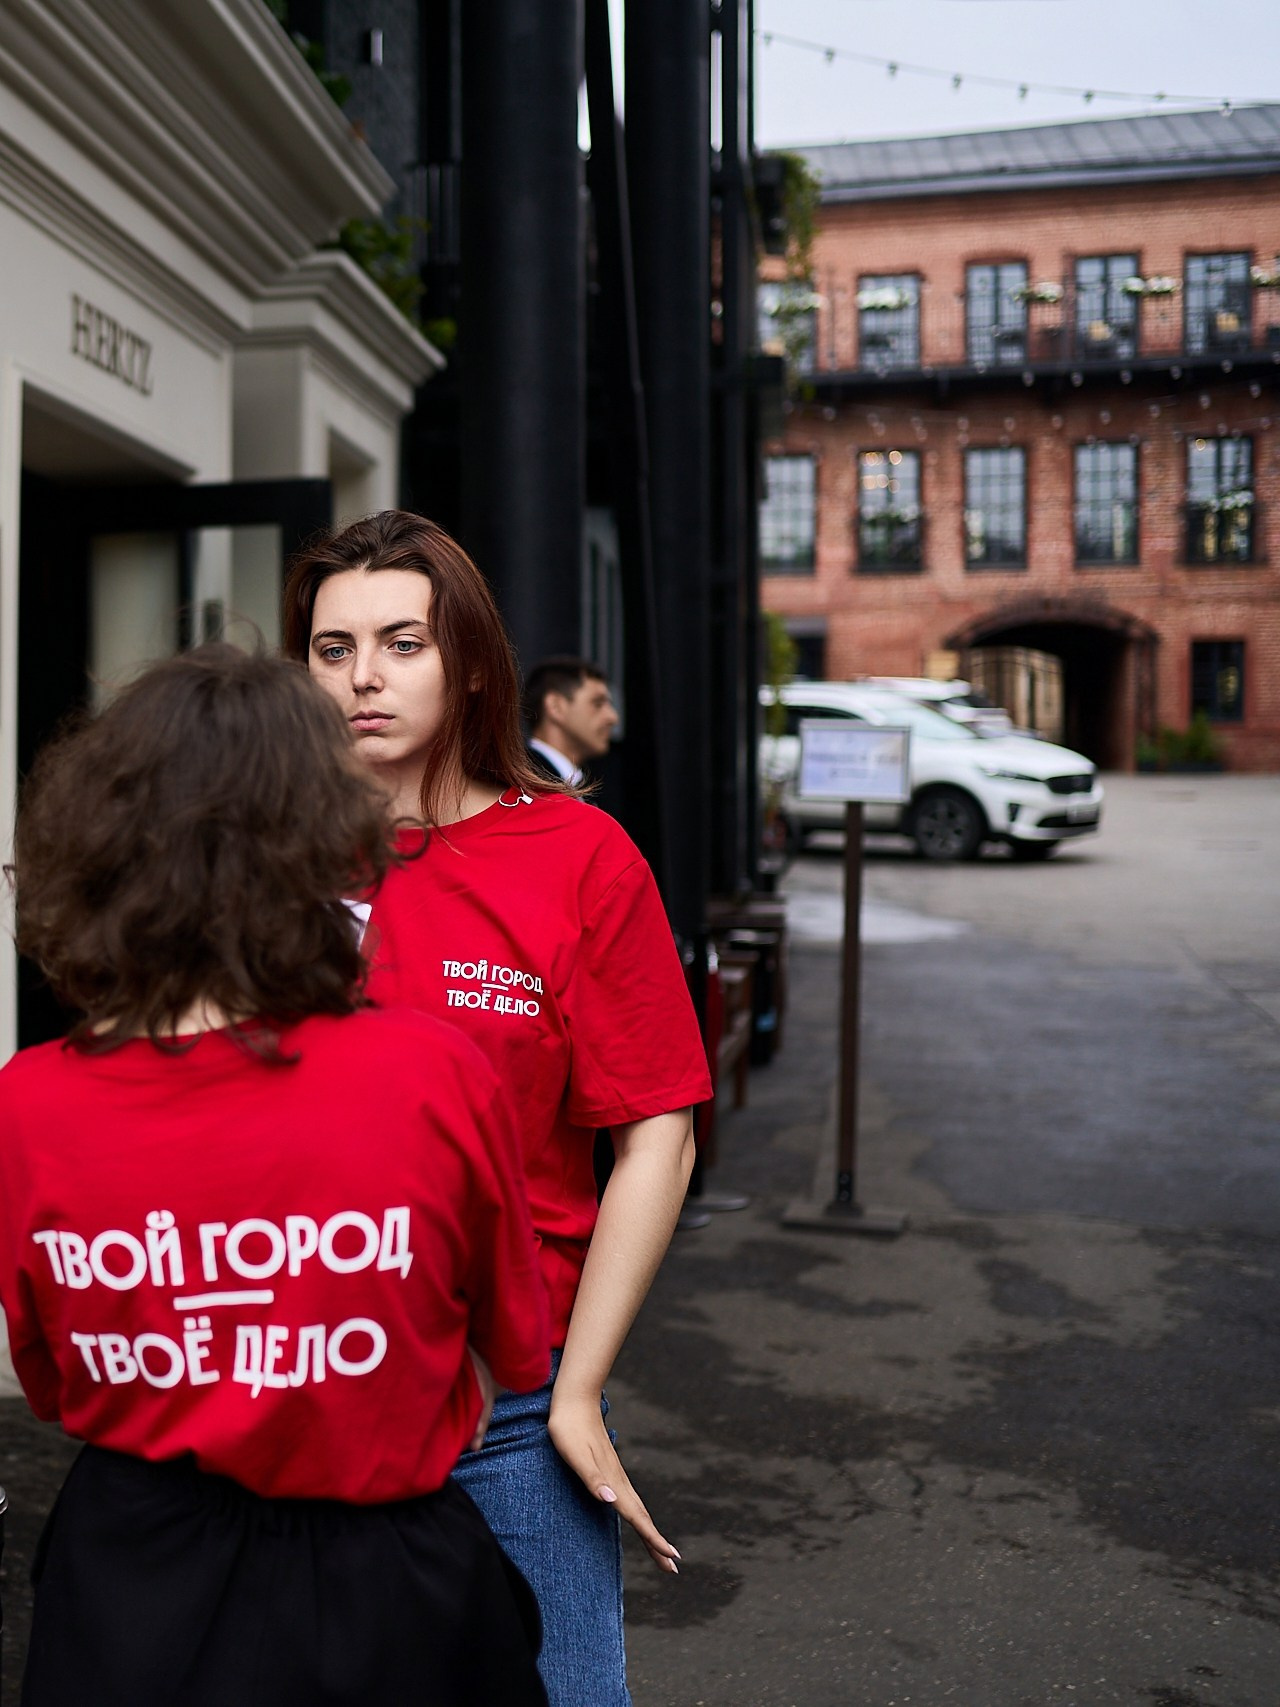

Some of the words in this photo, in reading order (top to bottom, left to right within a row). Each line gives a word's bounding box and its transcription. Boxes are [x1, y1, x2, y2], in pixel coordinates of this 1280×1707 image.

[442, 959, 488, 981] ТВОЙ
[491, 965, 544, 995] ГОРОД
[446, 989, 490, 1010] ТВОЁ
[493, 994, 540, 1017] ДЕЛО
[32, 1209, 185, 1291] ТВОЙ
[198, 1206, 414, 1280] ГОРОД
[70, 1315, 220, 1389] ТВОЁ
[232, 1317, 388, 1399] ДЕЛО
